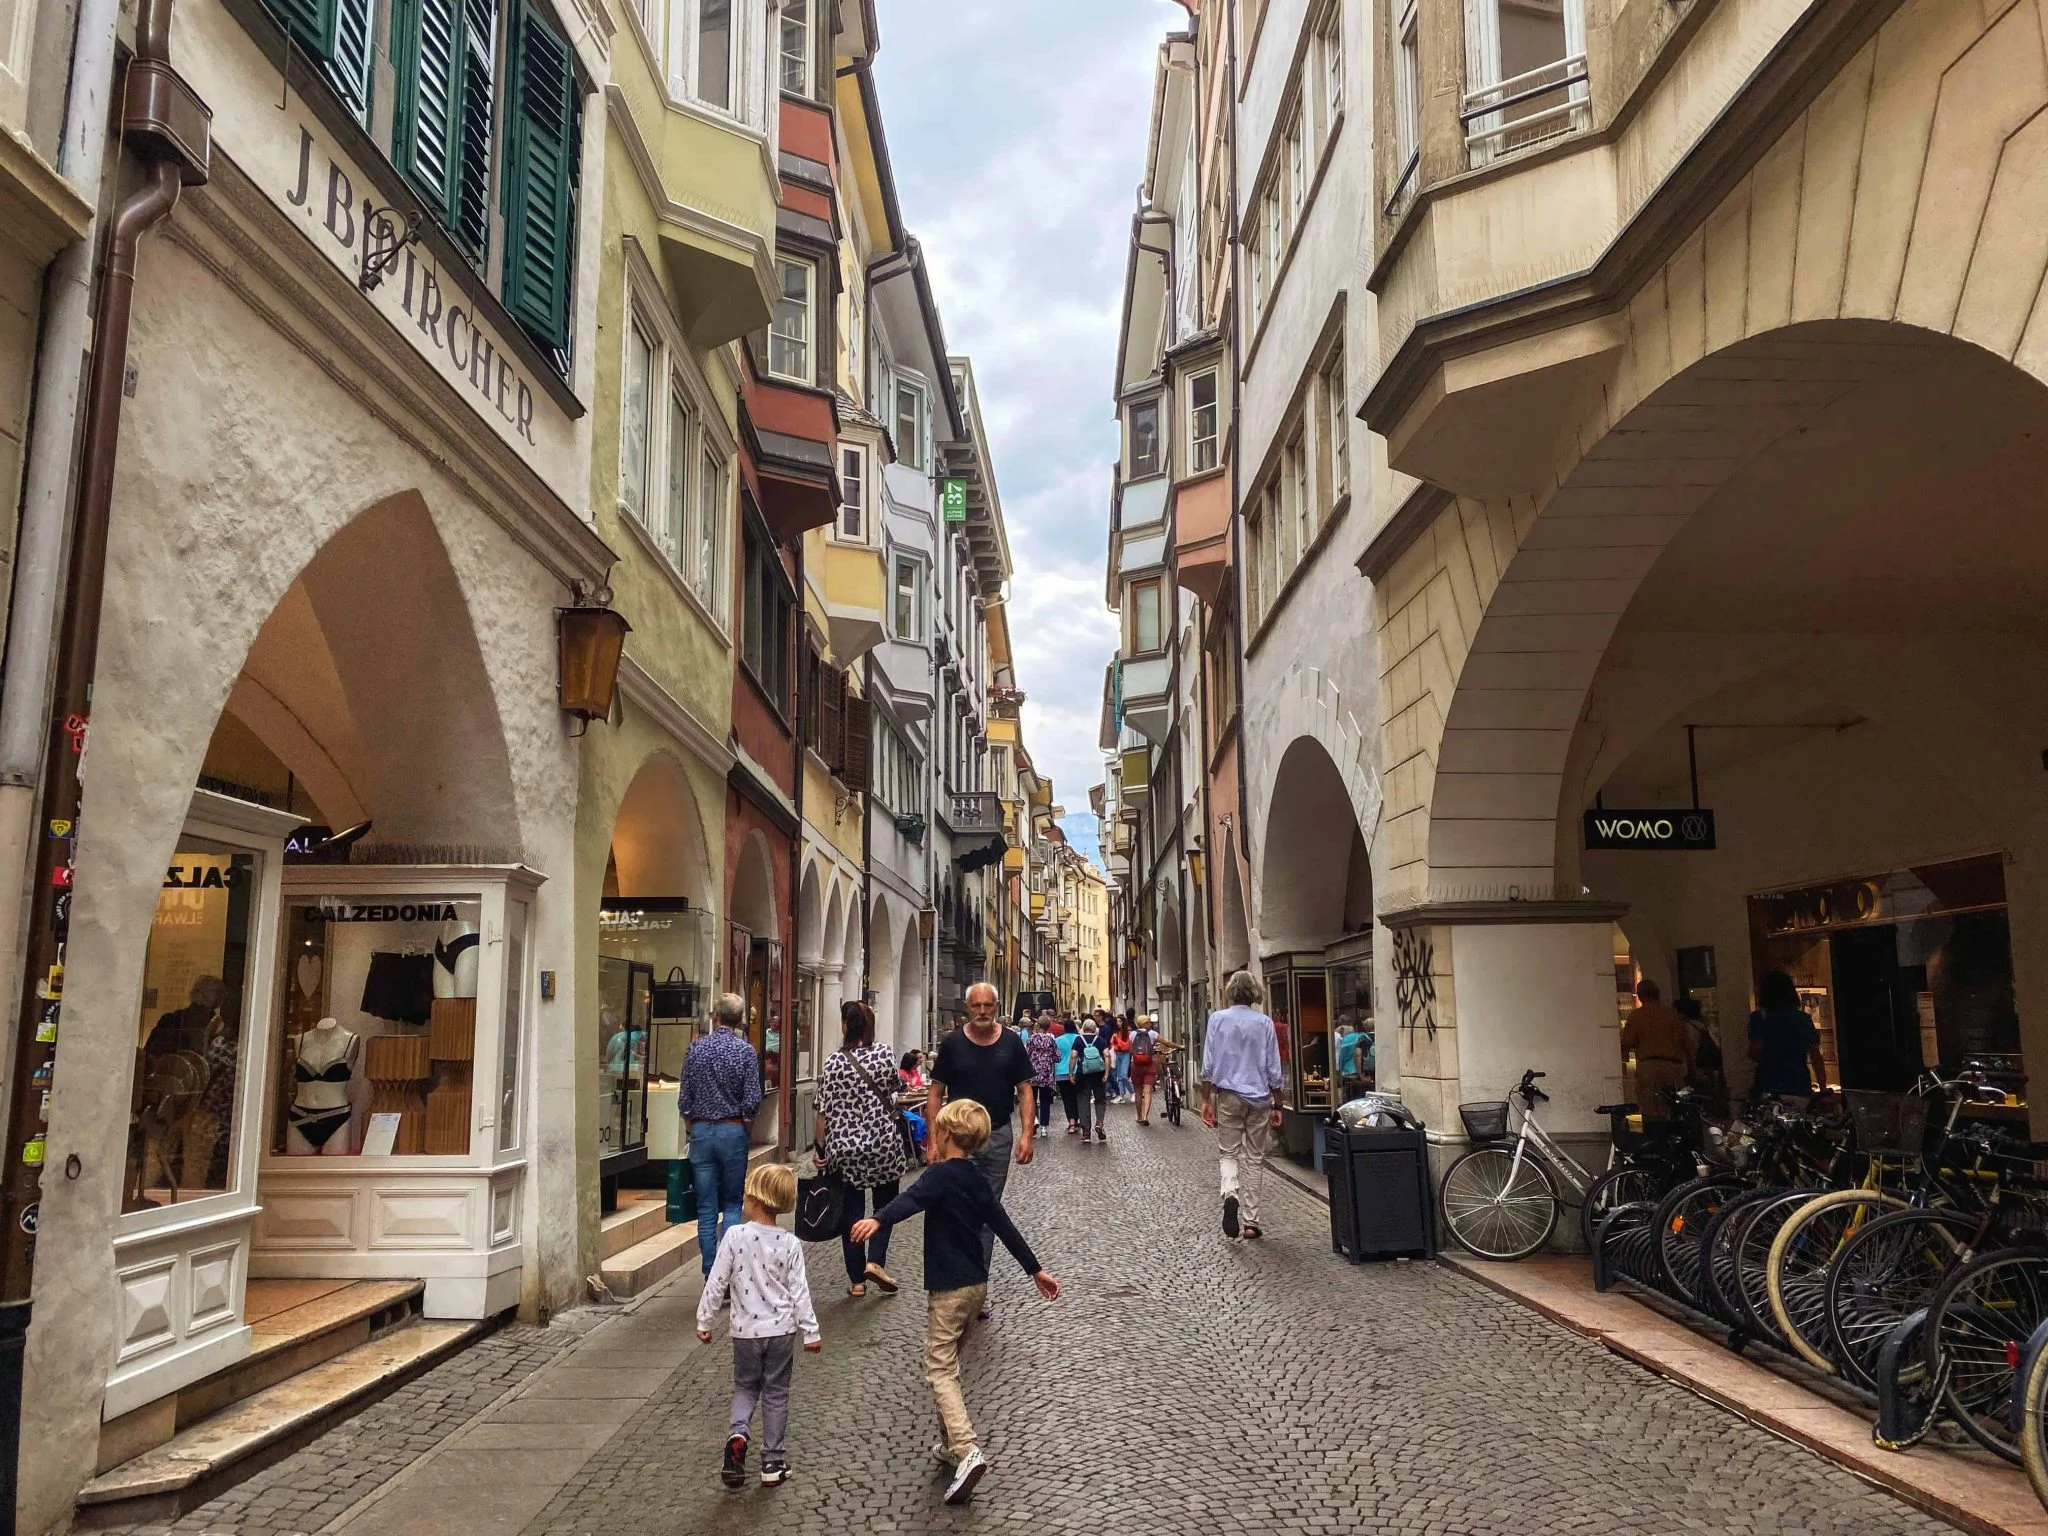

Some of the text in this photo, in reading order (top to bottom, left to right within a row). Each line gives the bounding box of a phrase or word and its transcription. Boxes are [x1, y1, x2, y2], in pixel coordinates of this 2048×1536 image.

[947, 482, 962, 505] 37
[1595, 819, 1673, 839] WOMO
[303, 905, 458, 923] CALZEDONIA
